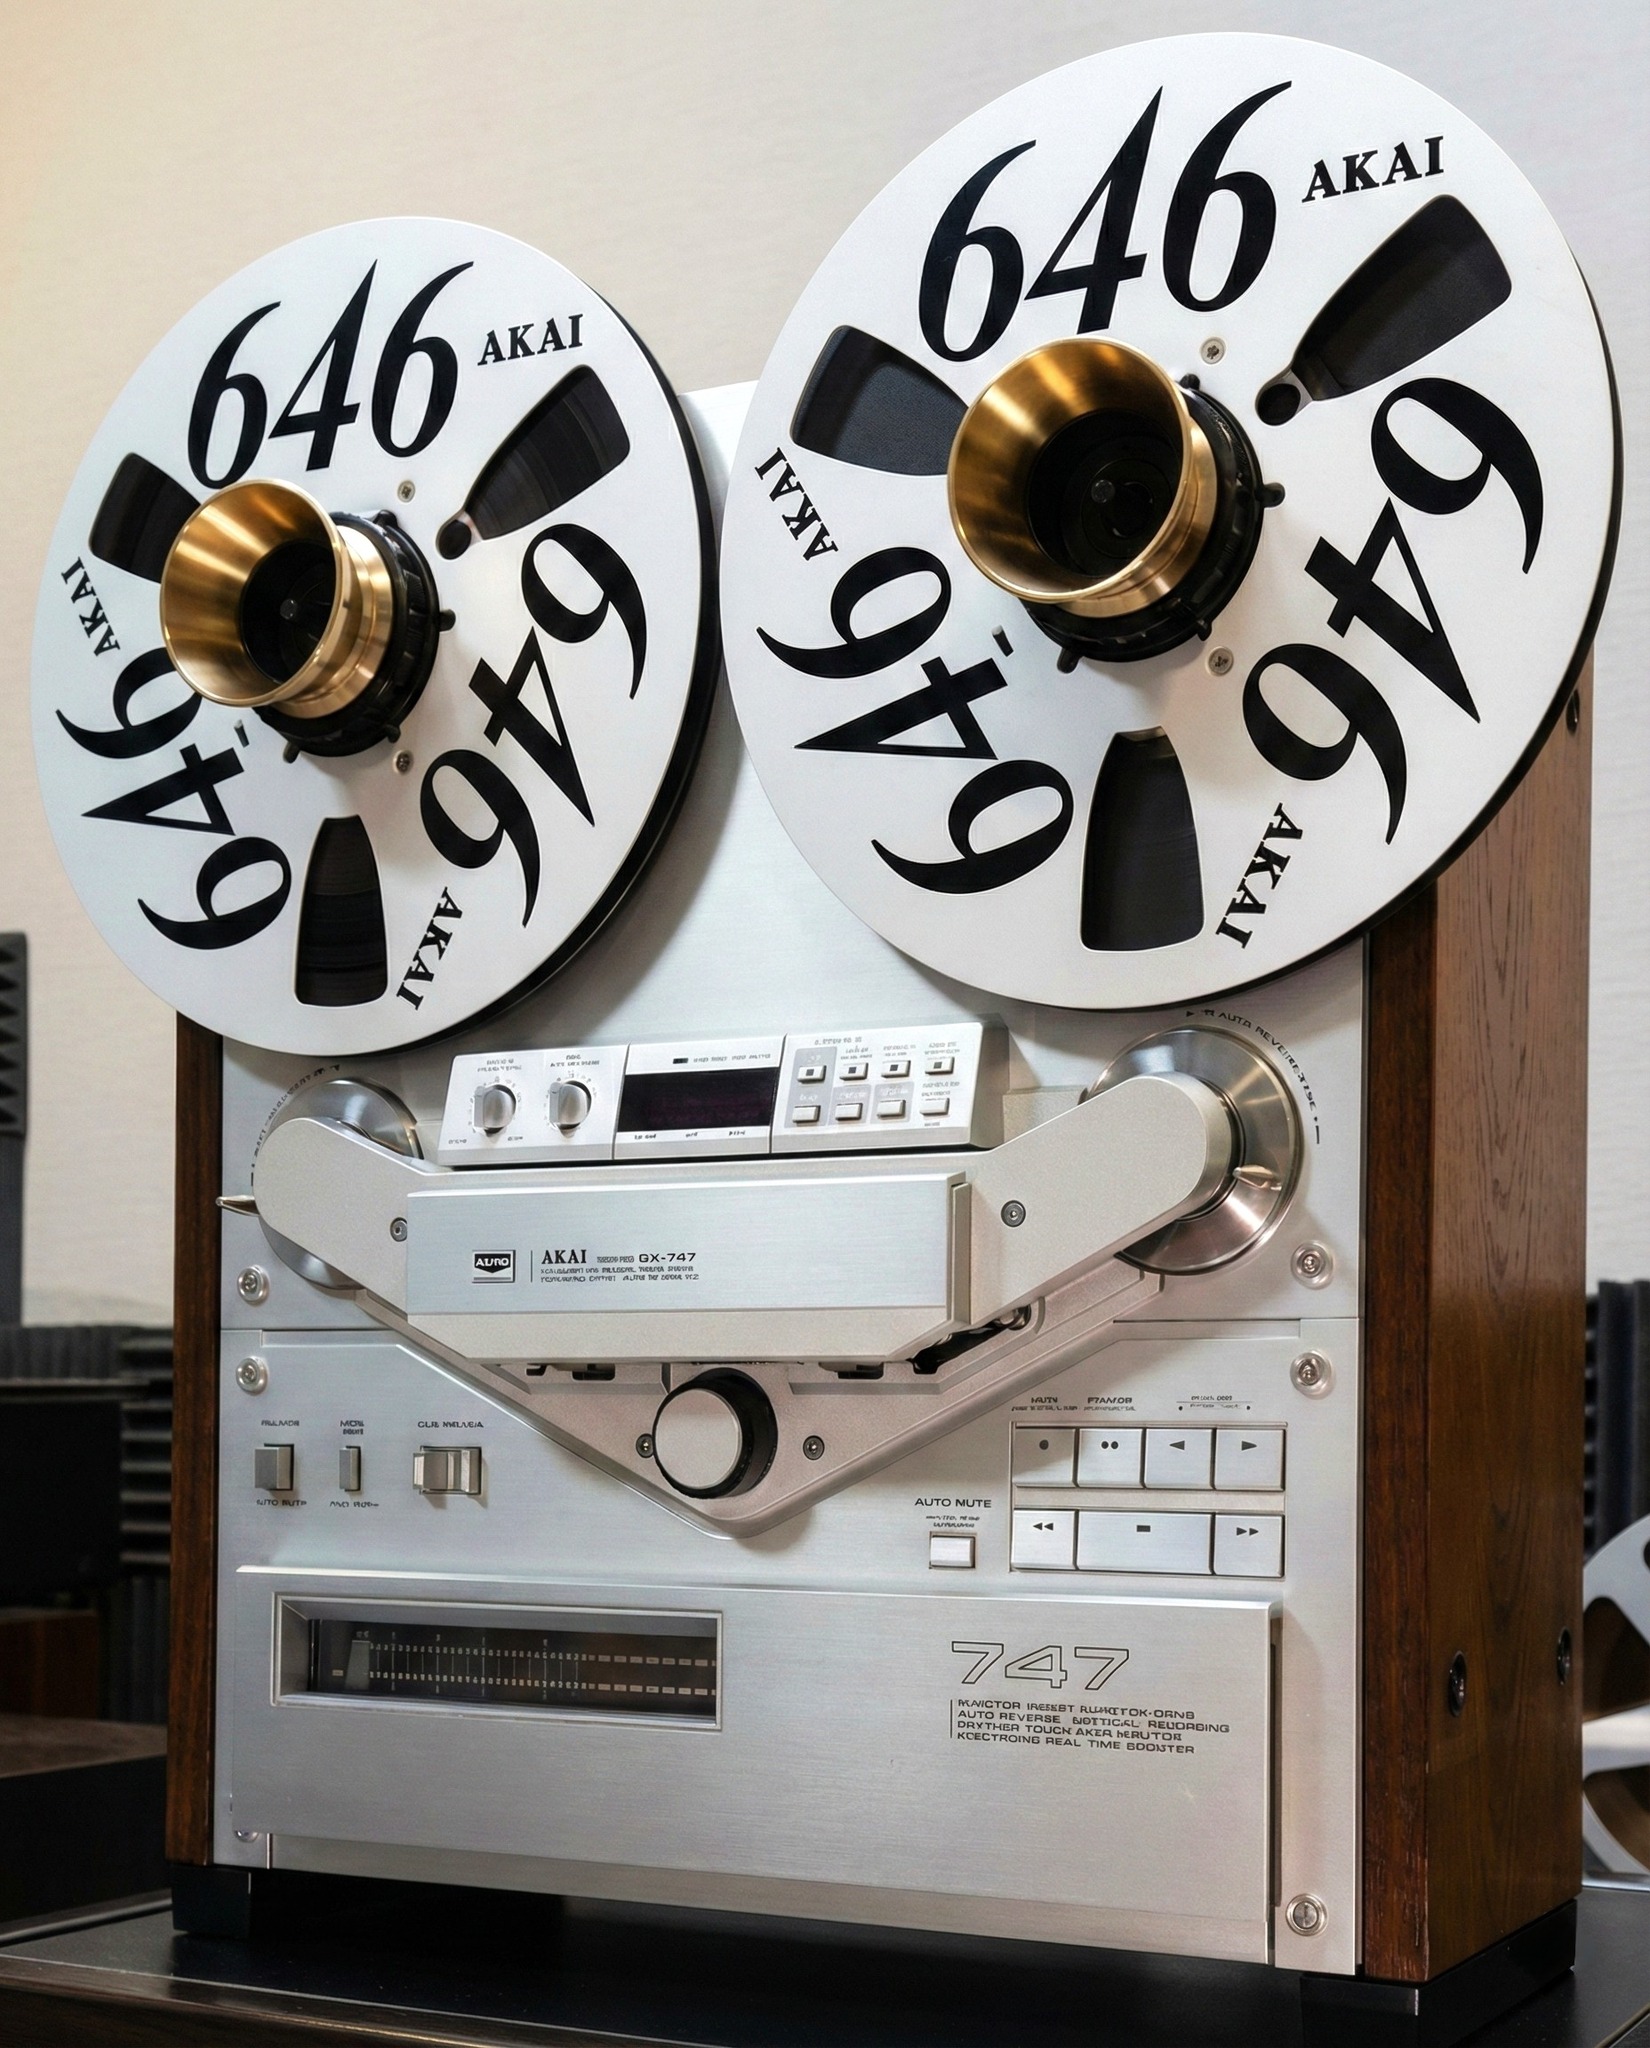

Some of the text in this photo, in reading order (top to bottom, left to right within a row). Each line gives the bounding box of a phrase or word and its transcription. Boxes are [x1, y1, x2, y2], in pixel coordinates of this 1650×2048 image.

[919, 81, 1292, 363] 646
[1302, 135, 1444, 203] AKAI
[188, 261, 474, 490] 646
[477, 313, 585, 366] AKAI
[755, 447, 839, 561] AKAI
[61, 557, 121, 657] AKAI
[1243, 377, 1544, 846] 646
[420, 523, 648, 928] 646
[756, 546, 1075, 895] 646
[1215, 802, 1304, 949] AKAI
[396, 886, 463, 1011] AKAI
[541, 1249, 587, 1265] AKAI
[638, 1252, 696, 1263] GX-747
[915, 1497, 992, 1508] AUTO MUTE
[952, 1641, 1130, 1691] 747
[957, 1709, 995, 1720] AUTO
[999, 1712, 1062, 1724] REVERSE
[1045, 1736, 1082, 1747] REAL
[1087, 1739, 1121, 1750] TIME
